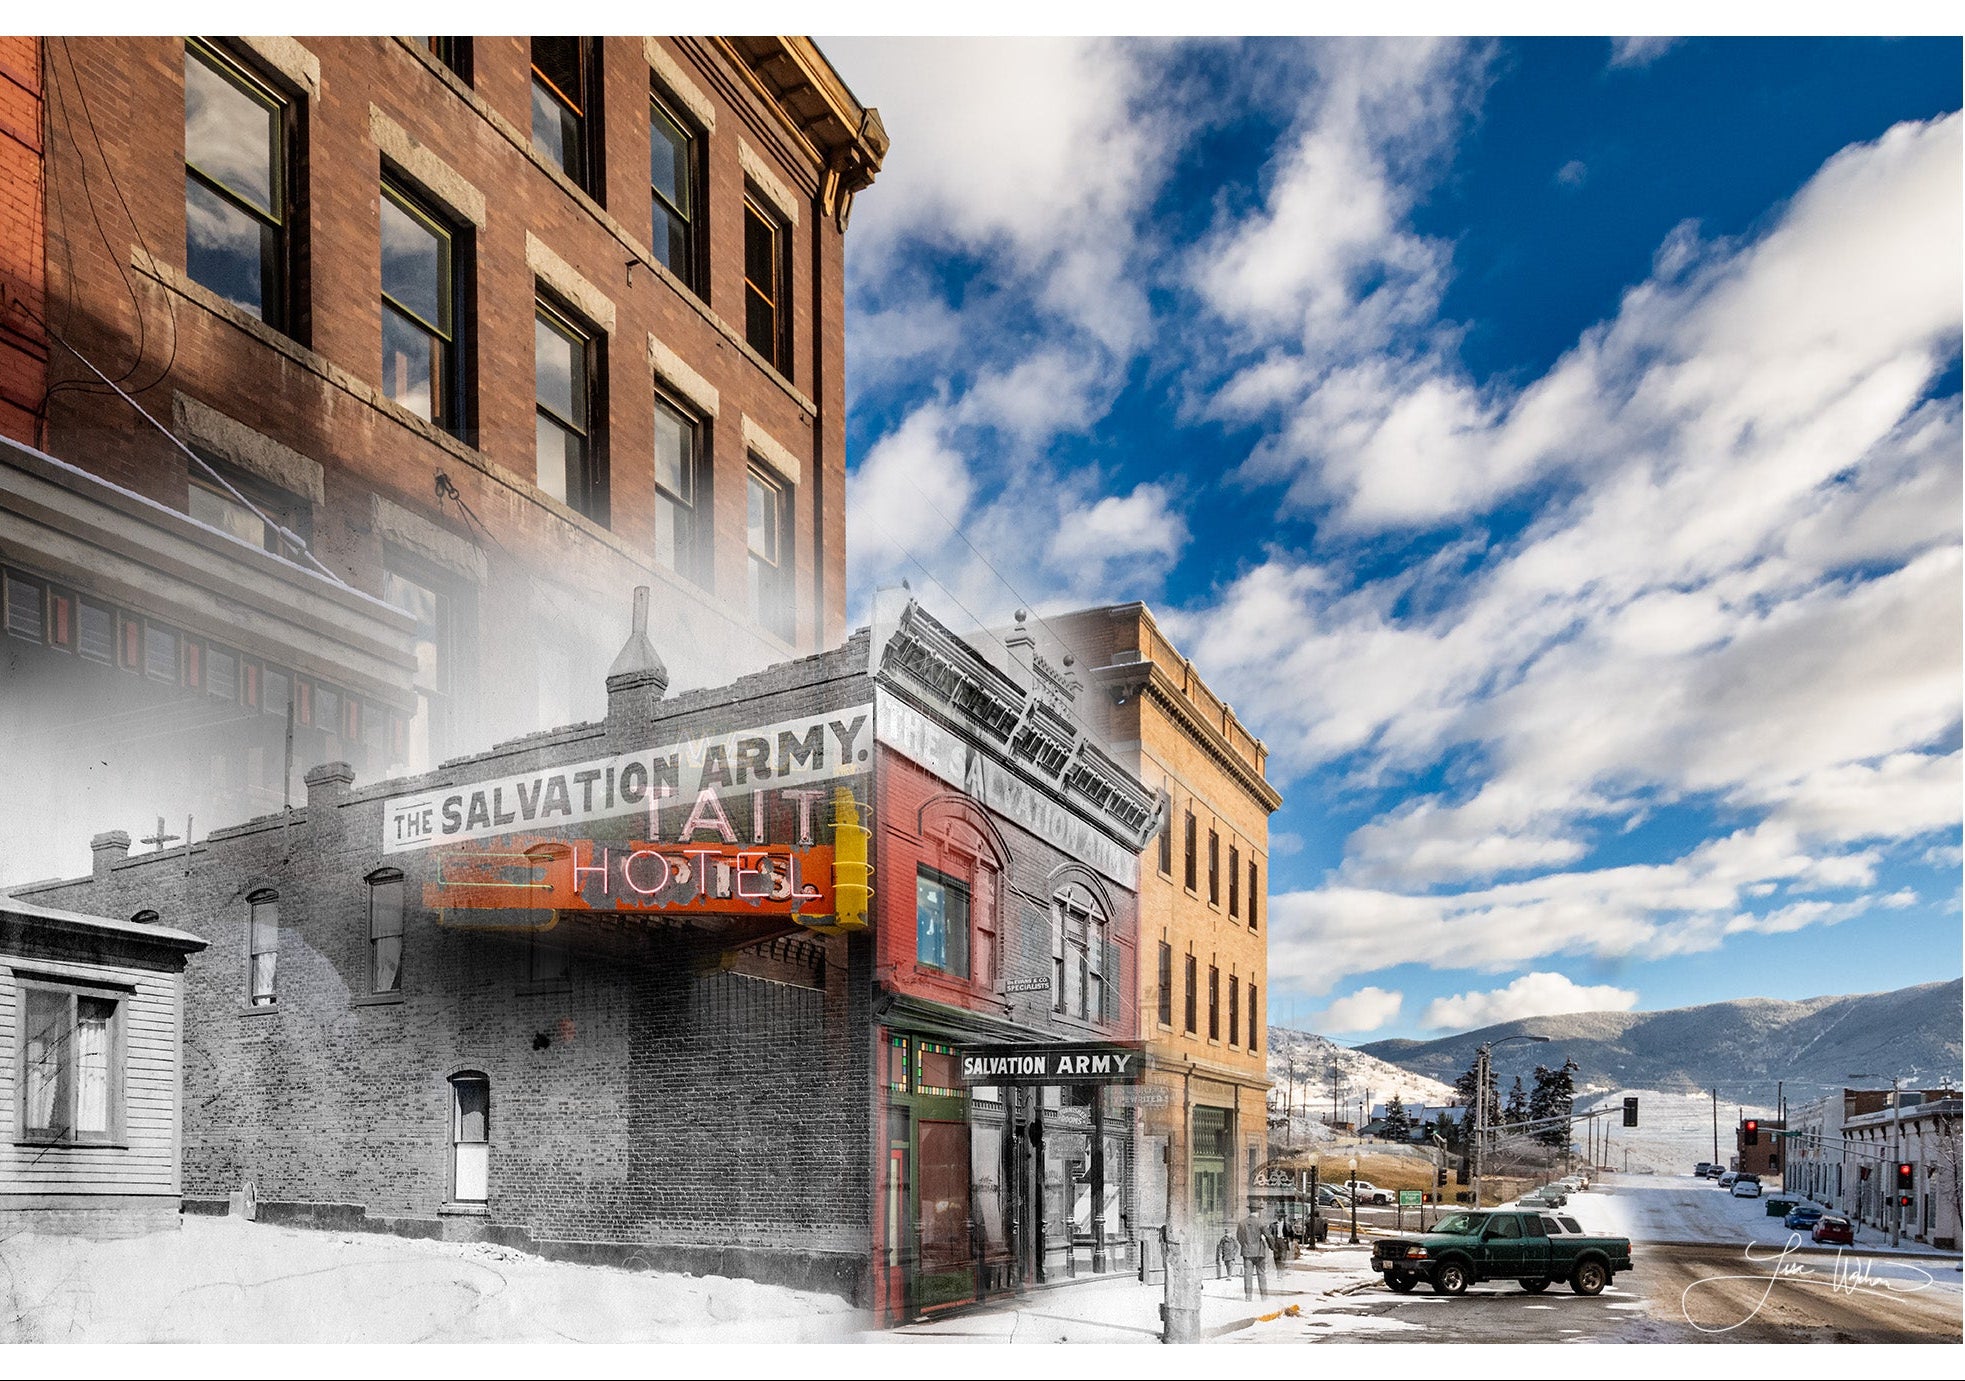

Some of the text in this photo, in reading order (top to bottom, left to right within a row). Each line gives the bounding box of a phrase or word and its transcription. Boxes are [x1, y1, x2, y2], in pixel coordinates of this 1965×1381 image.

[393, 808, 433, 841] THE
[441, 752, 680, 835] SALVATION
[630, 783, 827, 846] TAIT
[573, 846, 823, 899] HOTEL
[1006, 982, 1050, 992] SPECIALISTS
[964, 1054, 1132, 1076] SALVATION ARMY
